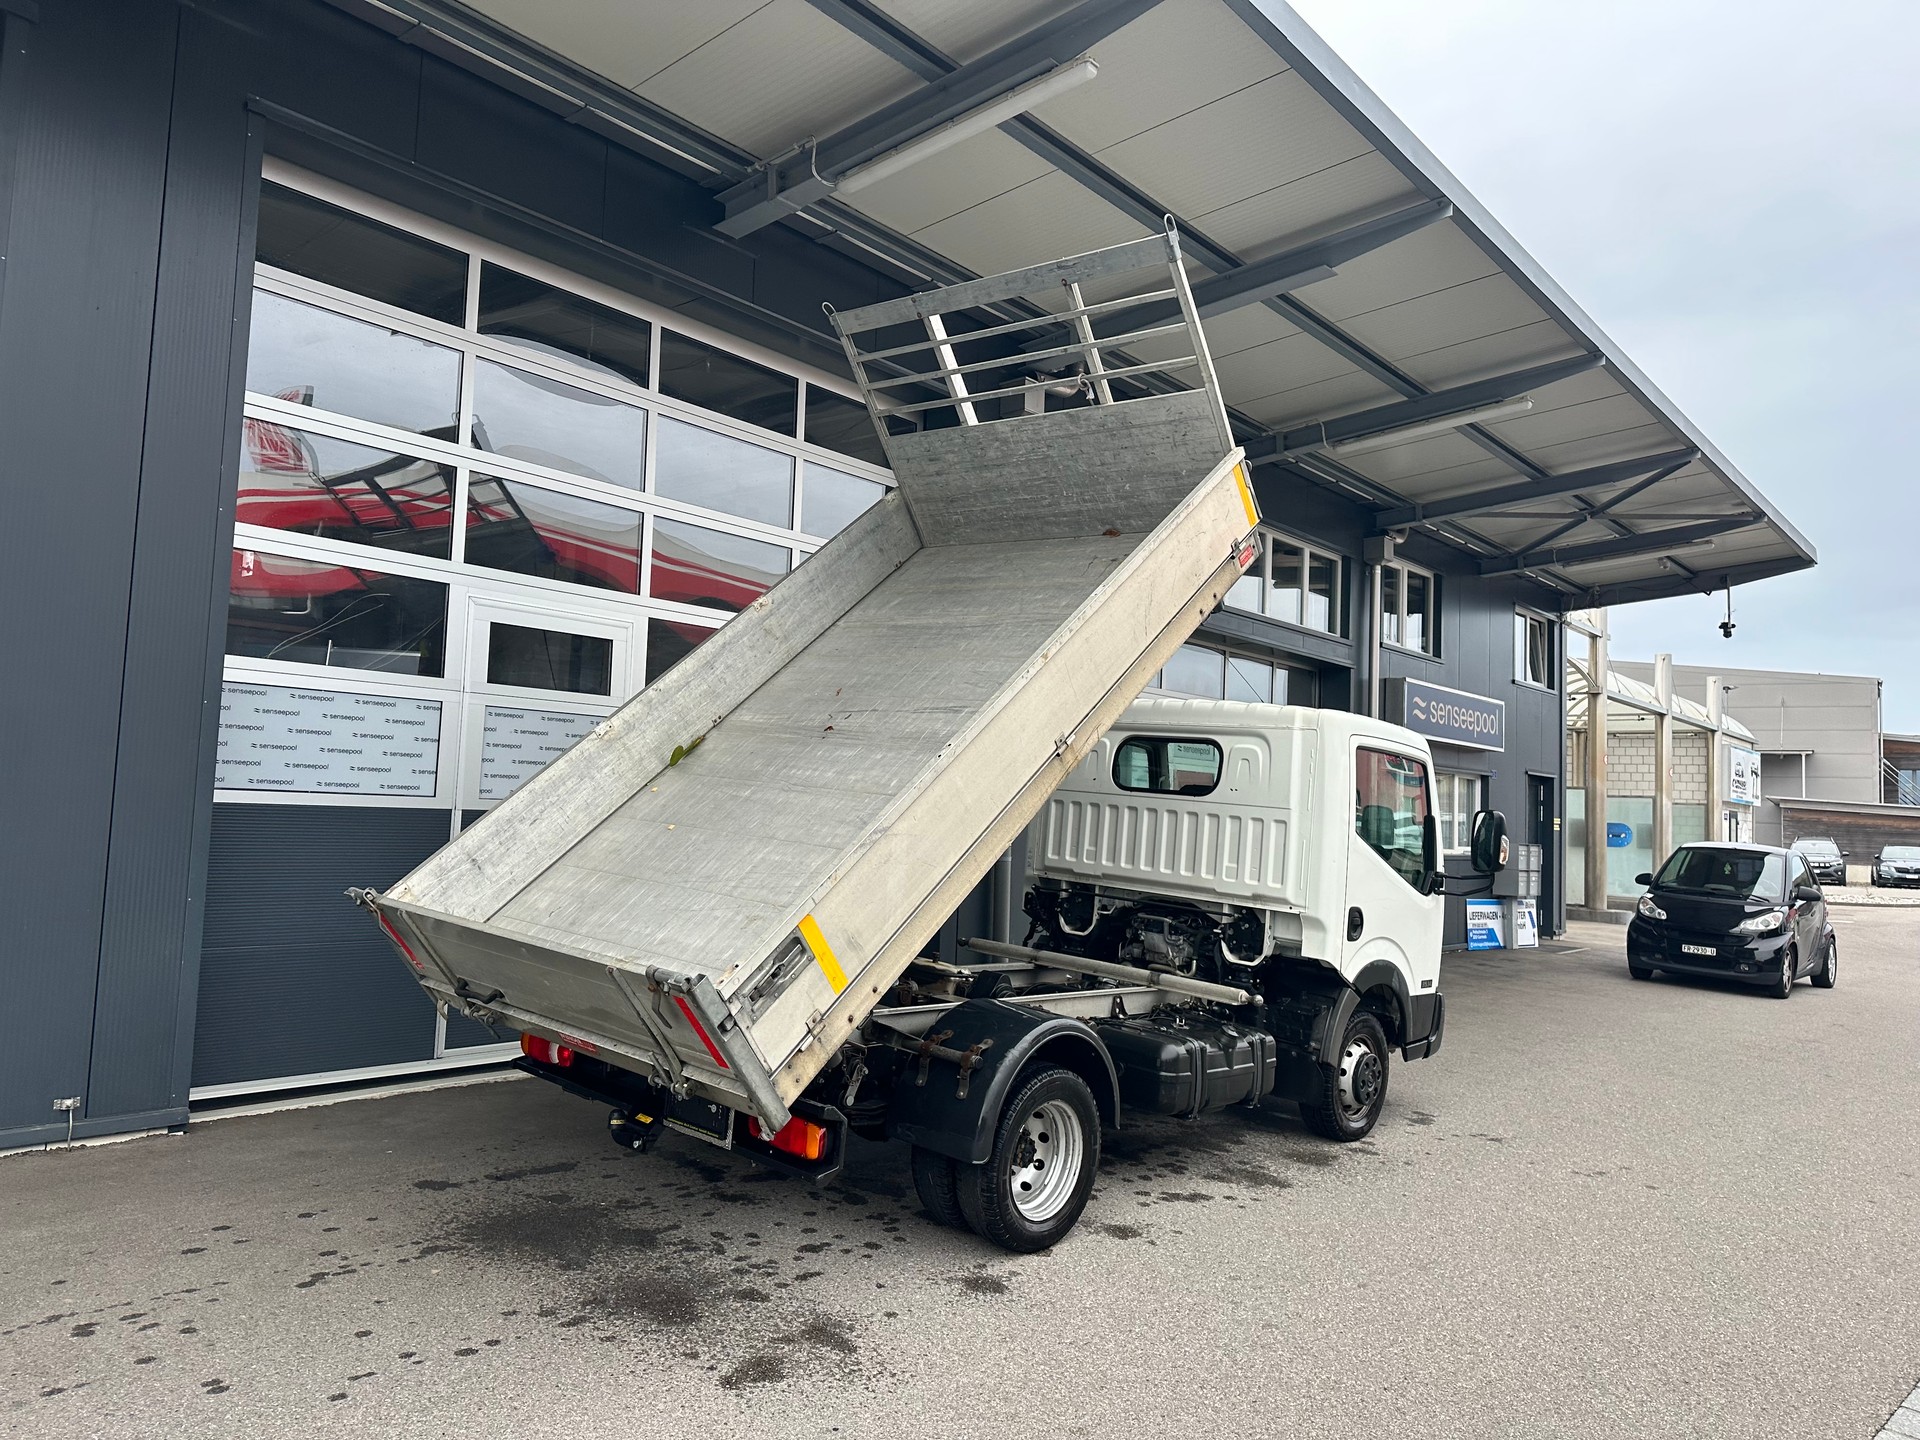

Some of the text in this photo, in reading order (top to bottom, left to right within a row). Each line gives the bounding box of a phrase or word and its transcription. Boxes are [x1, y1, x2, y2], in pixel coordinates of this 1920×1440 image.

[227, 687, 267, 697] senseepool
[297, 693, 335, 702] senseepool
[361, 699, 397, 708] senseepool
[261, 708, 301, 717] senseepool
[494, 711, 525, 719] senseepool
[329, 713, 366, 722] senseepool
[546, 716, 575, 724] senseepool
[1429, 701, 1499, 738] senseepool
[391, 718, 426, 727] senseepool
[224, 723, 265, 732] senseepool
[294, 728, 332, 736] senseepool
[359, 732, 395, 741] senseepool
[519, 729, 549, 737] senseepool
[258, 742, 298, 751] senseepool
[491, 742, 523, 750] senseepool
[326, 747, 363, 756] senseepool
[389, 751, 423, 759] senseepool
[221, 759, 262, 767] senseepool
[291, 762, 330, 771] senseepool
[517, 759, 547, 767] senseepool
[356, 766, 392, 774] senseepool
[255, 777, 295, 787] senseepool
[323, 781, 360, 789] senseepool
[386, 784, 421, 792] senseepool
